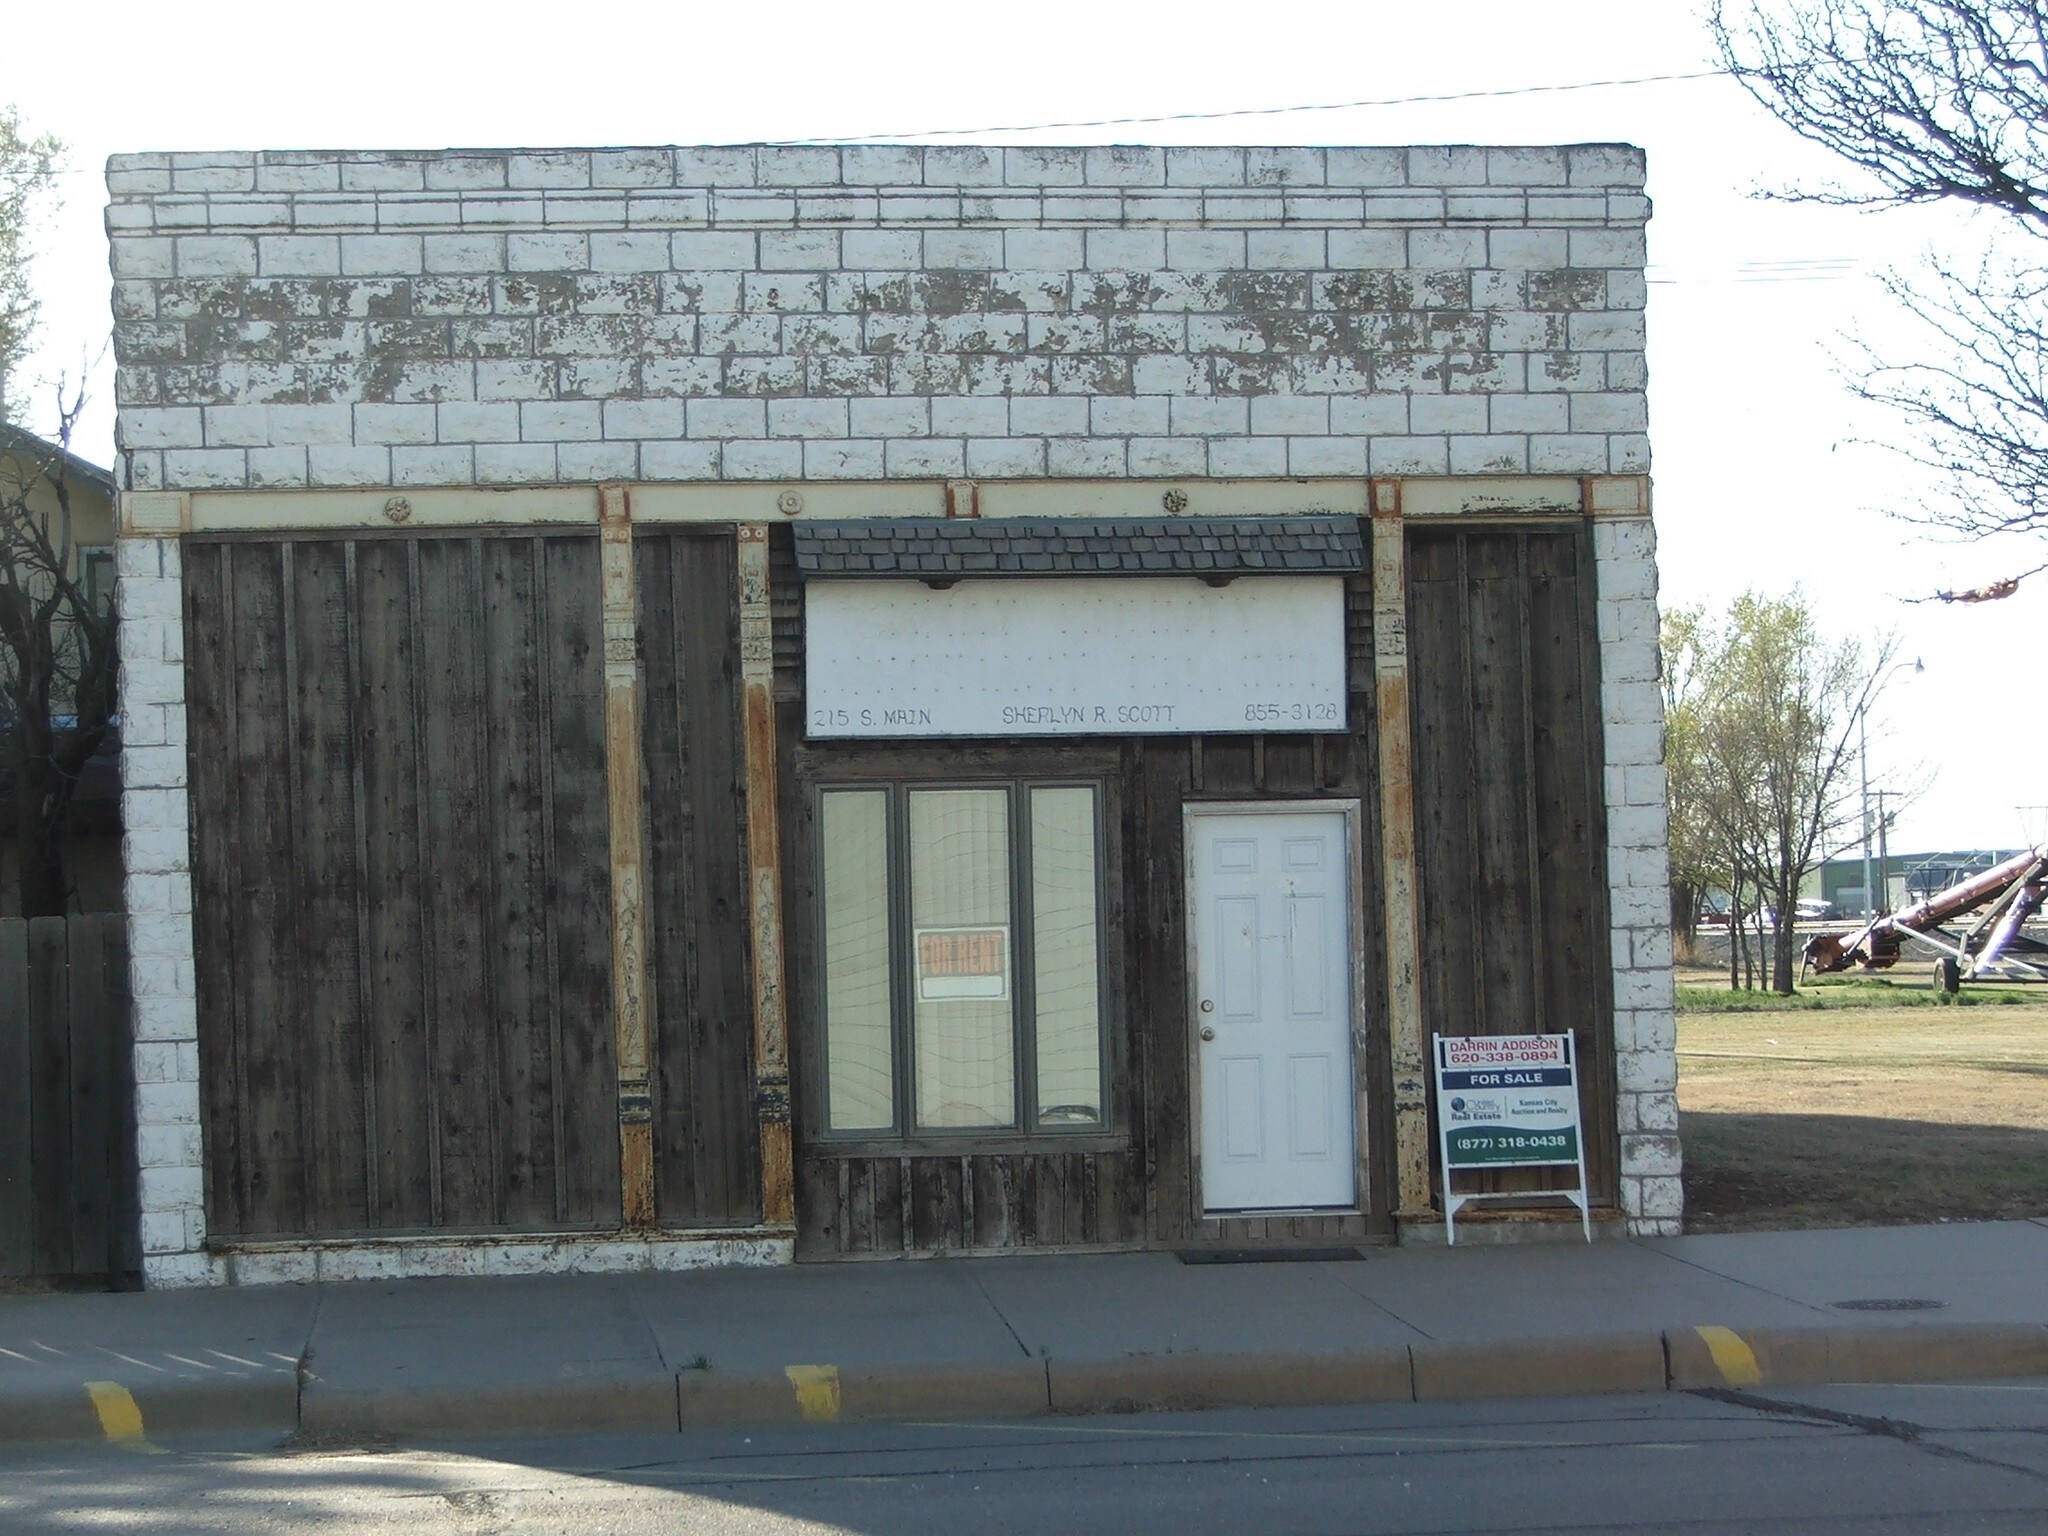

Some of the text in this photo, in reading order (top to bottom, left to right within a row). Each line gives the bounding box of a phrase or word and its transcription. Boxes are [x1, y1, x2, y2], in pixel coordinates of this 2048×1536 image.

[814, 703, 1337, 727] 215 S. MAIN SHERLYN R. SCOTT 855-3128
[921, 934, 1001, 974] FOR RENT
[1450, 1040, 1558, 1052] DARRIN ADDISON
[1451, 1051, 1558, 1064] 620-338-0894
[1470, 1073, 1543, 1085] FOR SALE
[1519, 1098, 1558, 1107] Kansas City
[1451, 1112, 1502, 1121] Real Estate
[1548, 1106, 1568, 1115] Realty
[1457, 1135, 1566, 1150] (877) 318-0438
